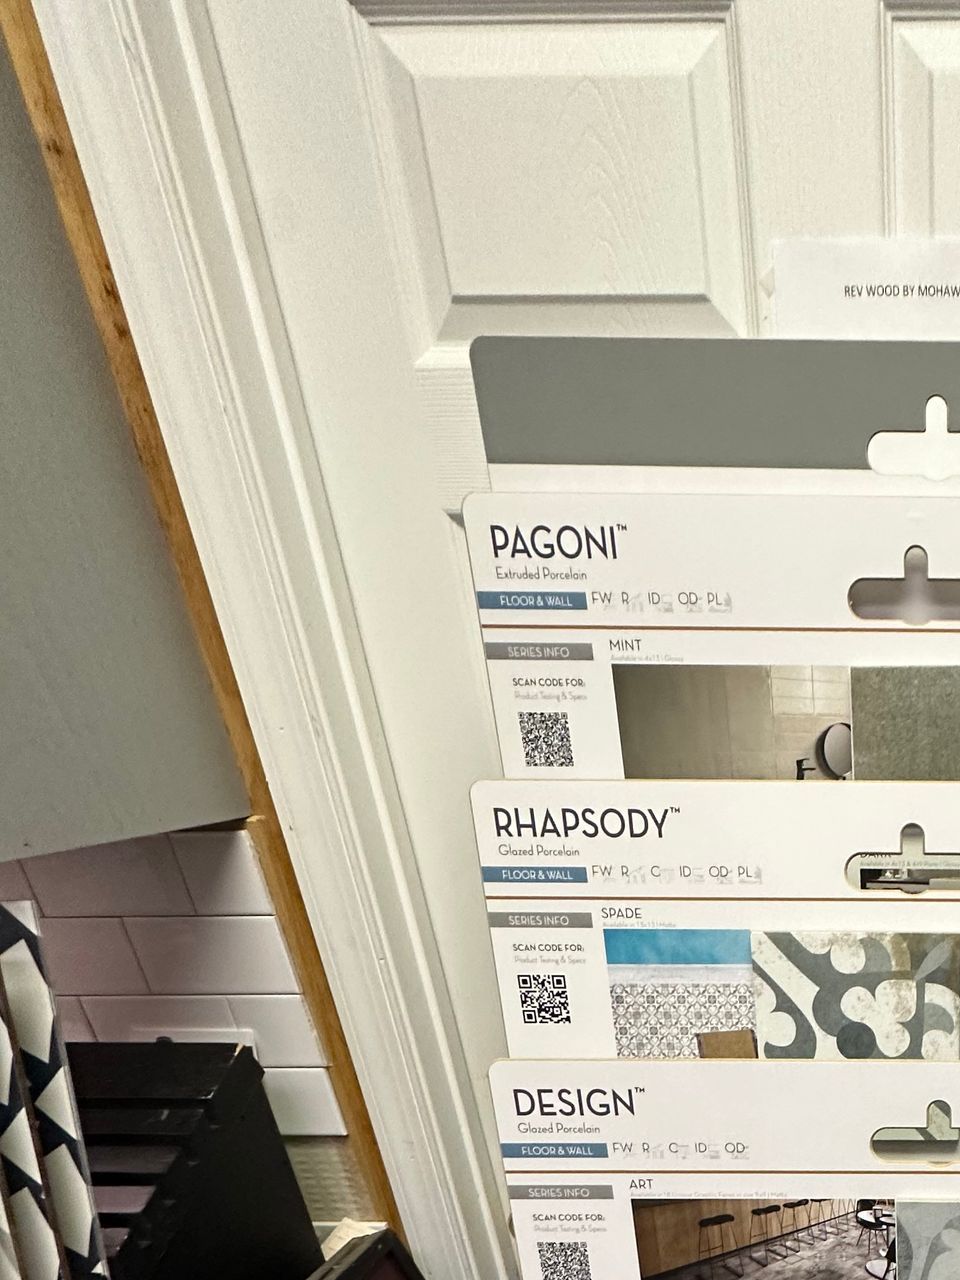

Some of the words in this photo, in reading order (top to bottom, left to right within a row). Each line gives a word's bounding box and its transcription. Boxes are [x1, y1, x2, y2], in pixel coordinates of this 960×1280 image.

[844, 285, 863, 297] REV
[866, 285, 900, 297] WOOD
[903, 285, 915, 297] BY
[496, 567, 541, 580] Extruded
[543, 567, 587, 580] Porcelain
[500, 596, 535, 606] FLOOR
[537, 596, 543, 606] &
[545, 596, 572, 606] WALL
[609, 639, 642, 651] MINT
[508, 647, 541, 658] SERIES
[544, 647, 570, 658] INFO
[512, 678, 536, 687] SCAN
[539, 678, 563, 687] CODE
[566, 678, 585, 687] FOR:
[498, 844, 533, 856] Glazed
[536, 844, 580, 856] Porcelain
[502, 870, 536, 880] FLOOR
[538, 870, 545, 880] &
[546, 870, 573, 880] WALL
[601, 907, 642, 919] SPADE
[508, 916, 542, 925] SERIES
[544, 916, 569, 925] INFO
[512, 944, 536, 952] SCAN
[538, 944, 563, 952] CODE
[565, 944, 585, 952] FOR:
[517, 1122, 553, 1134] Glazed
[556, 1122, 600, 1134] Porcelain
[521, 1146, 556, 1155] FLOOR
[558, 1146, 564, 1155] &
[565, 1146, 593, 1155] WALL
[630, 1179, 653, 1189] ART
[528, 1188, 562, 1197] SERIES
[564, 1188, 590, 1197] INFO
[532, 1214, 557, 1222] SCAN
[559, 1214, 583, 1222] CODE
[585, 1214, 605, 1222] FOR:
